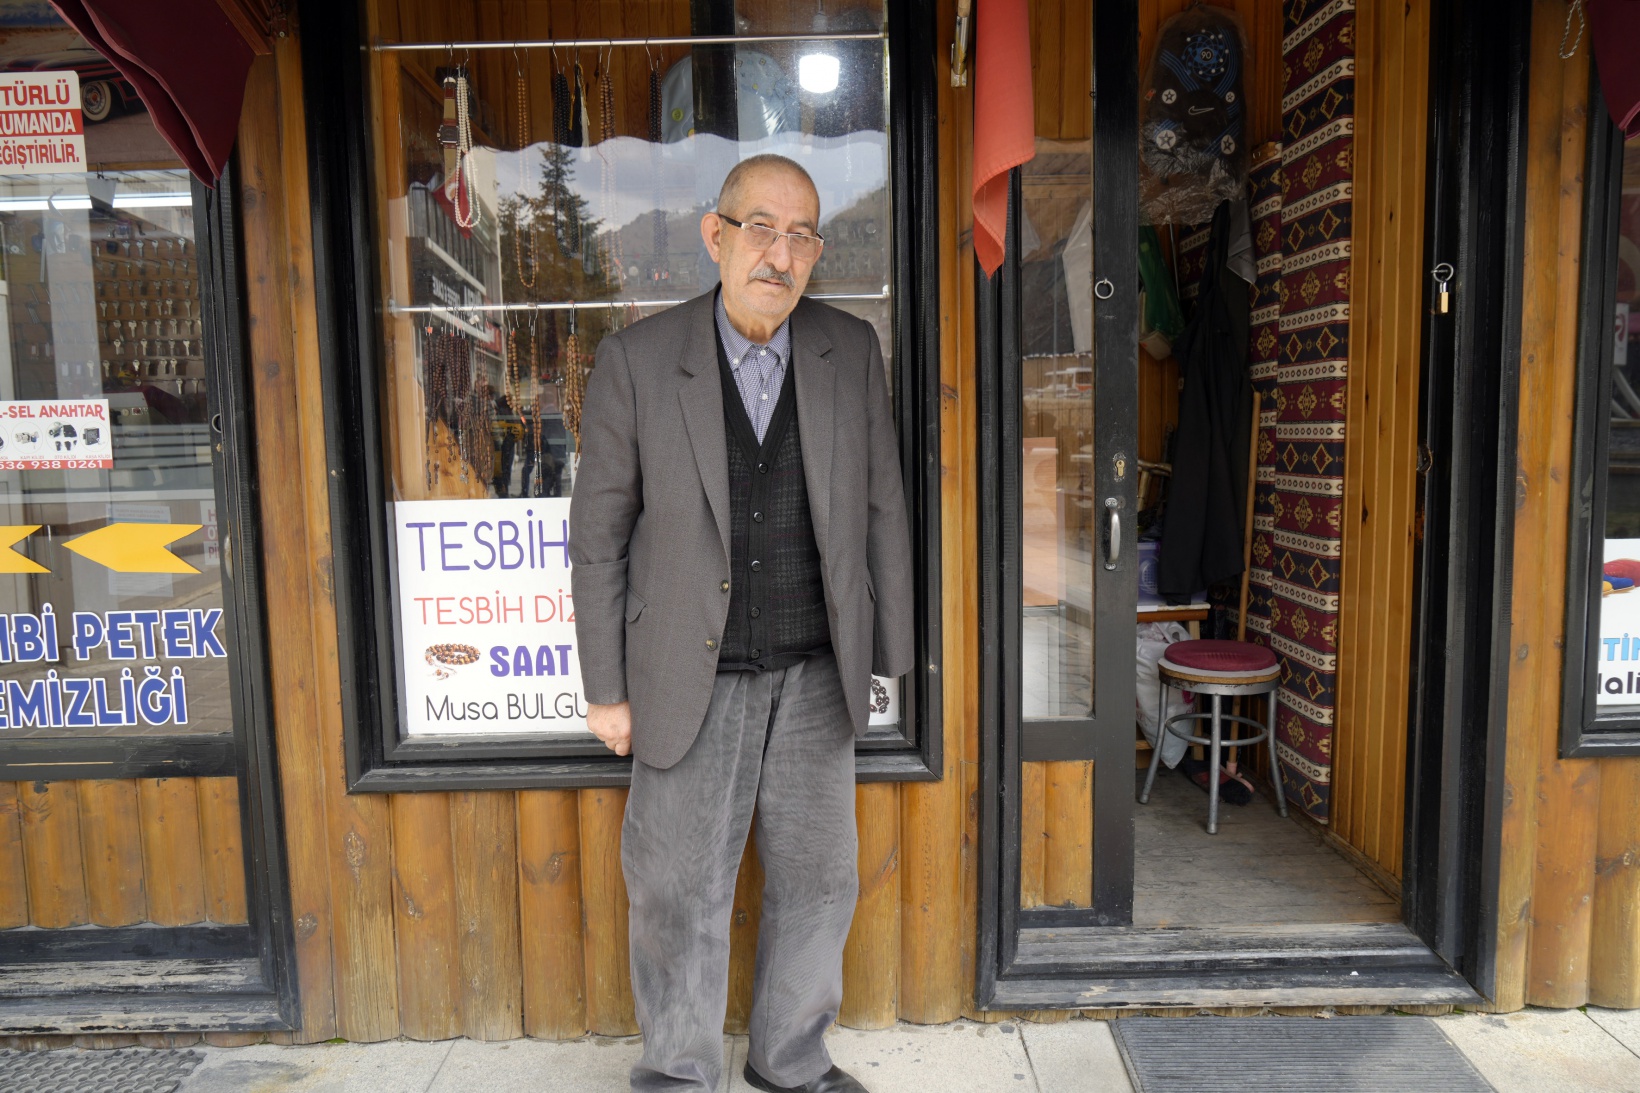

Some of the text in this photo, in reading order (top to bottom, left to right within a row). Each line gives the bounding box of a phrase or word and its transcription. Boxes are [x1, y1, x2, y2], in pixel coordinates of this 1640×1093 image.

[0, 79, 70, 106] TÜRLÜ
[0, 111, 76, 135] UMANDA
[0, 139, 80, 170] ĞİŞTİRİLİR.
[0, 404, 105, 420] -SEL ANAHTAR
[31, 460, 61, 469] 938
[67, 460, 103, 469] 0261
[405, 509, 569, 572] TESBİH
[414, 590, 523, 625] TESBİH
[72, 608, 228, 661] PETEK
[489, 644, 573, 678] SAAT
[0, 665, 188, 729] MİZLİĞİ
[425, 694, 498, 721] Musa
